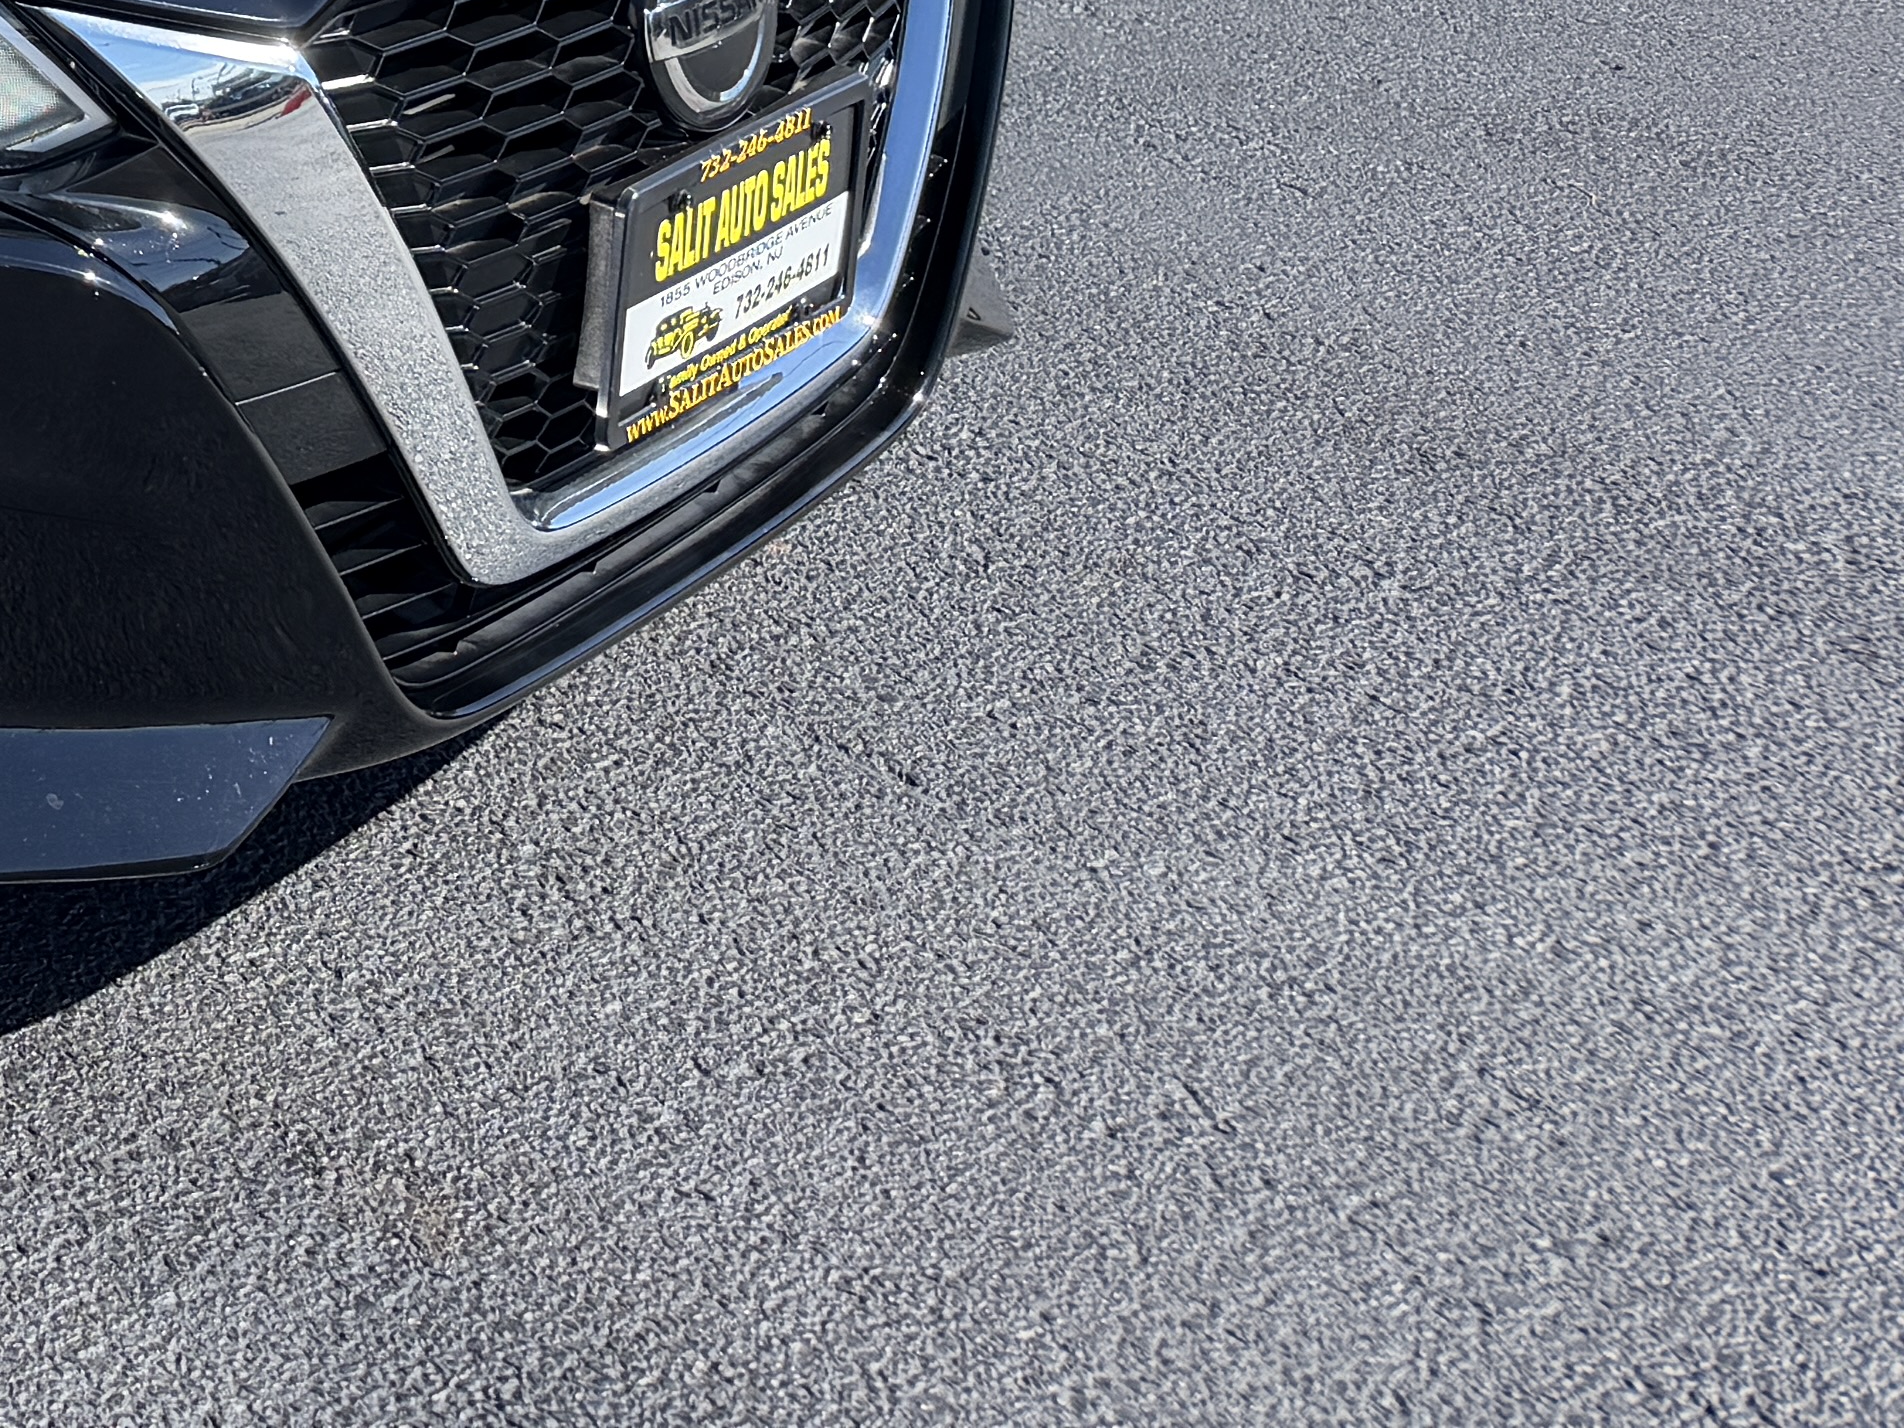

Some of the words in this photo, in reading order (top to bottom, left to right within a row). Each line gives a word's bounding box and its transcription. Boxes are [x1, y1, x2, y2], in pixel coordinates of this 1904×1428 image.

[700, 106, 813, 183] 732-246-4811
[655, 196, 717, 282] SALIT
[714, 170, 770, 253] AUTO
[770, 139, 831, 223] SALES
[660, 282, 691, 307] 1855
[695, 230, 784, 289] WOODBRIDGE
[784, 202, 833, 241] AVENUE
[735, 243, 831, 319] 732-246-4811
[766, 245, 784, 266] NJ
[666, 362, 700, 390] amily
